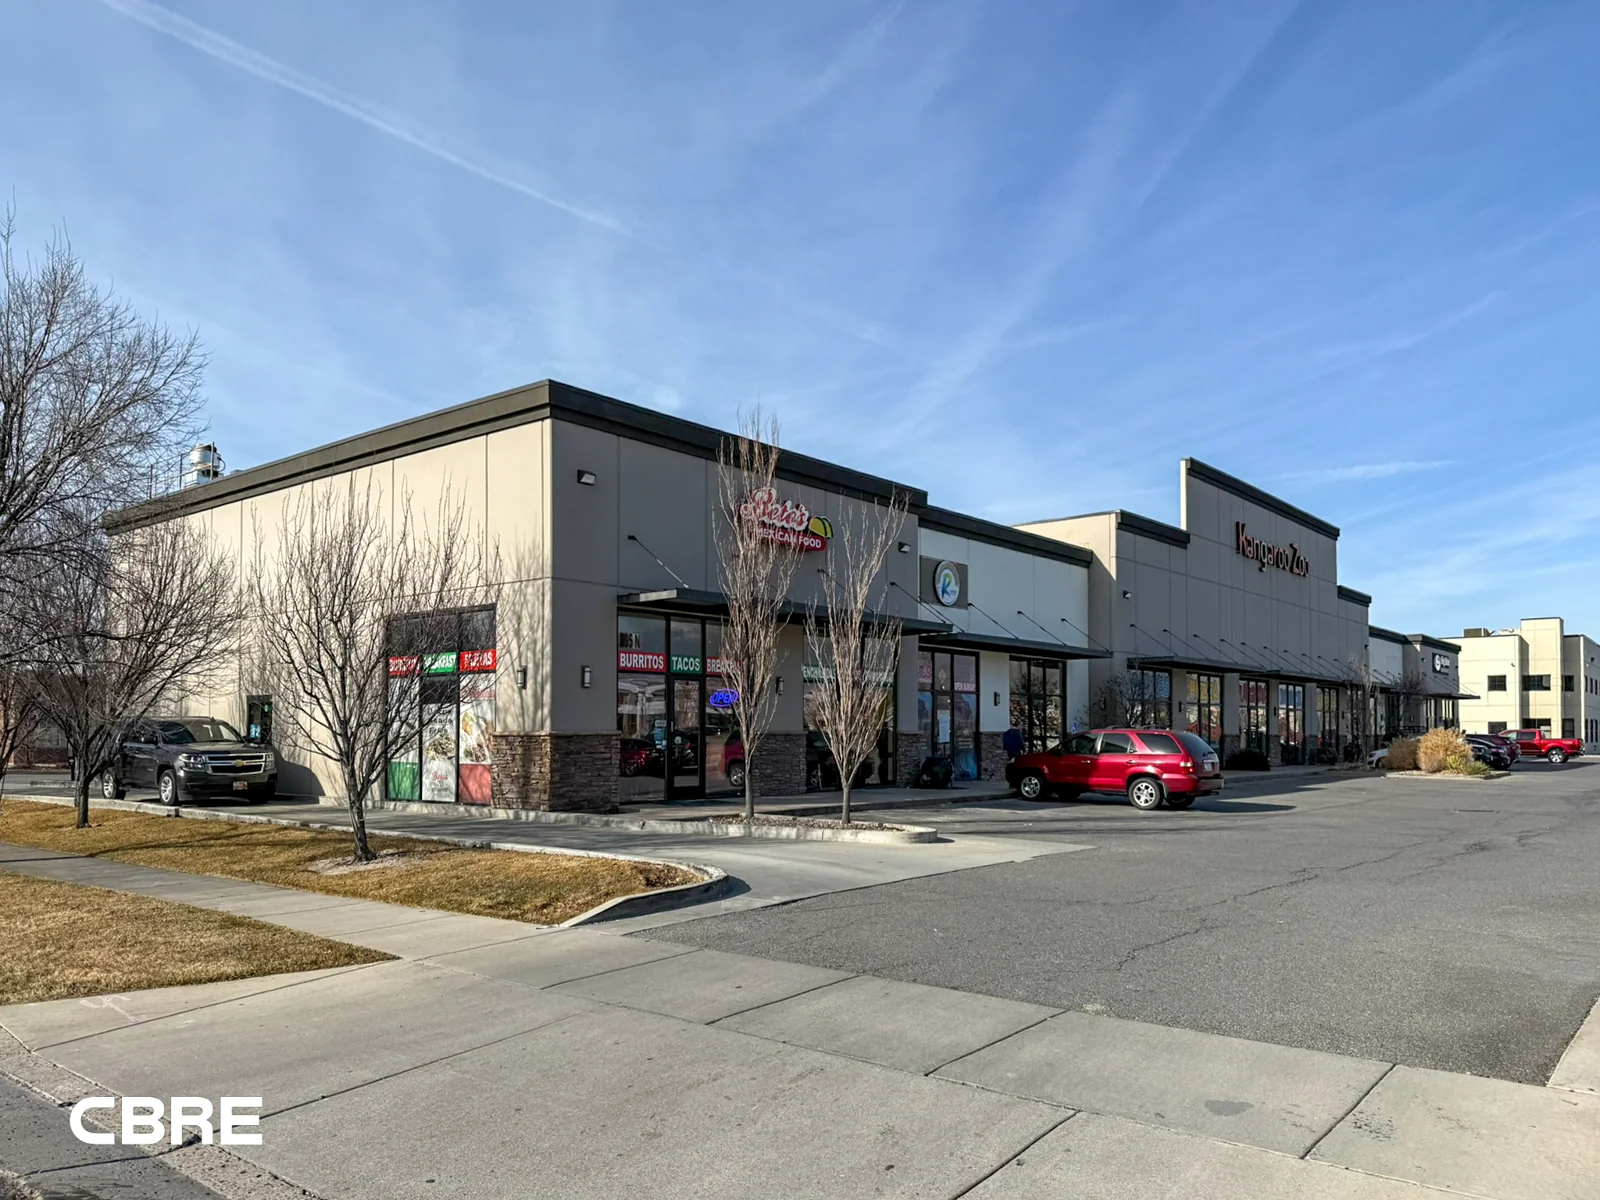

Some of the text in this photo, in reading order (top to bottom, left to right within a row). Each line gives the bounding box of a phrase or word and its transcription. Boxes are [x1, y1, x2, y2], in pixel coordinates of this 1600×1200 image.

[757, 528, 822, 548] MEXICAN FOOD
[1236, 521, 1309, 577] Kangaroo Zoo
[620, 653, 664, 669] BURRITOS
[672, 657, 700, 671] TACOS
[707, 659, 744, 673] BREAKFA
[712, 692, 736, 703] OPEN
